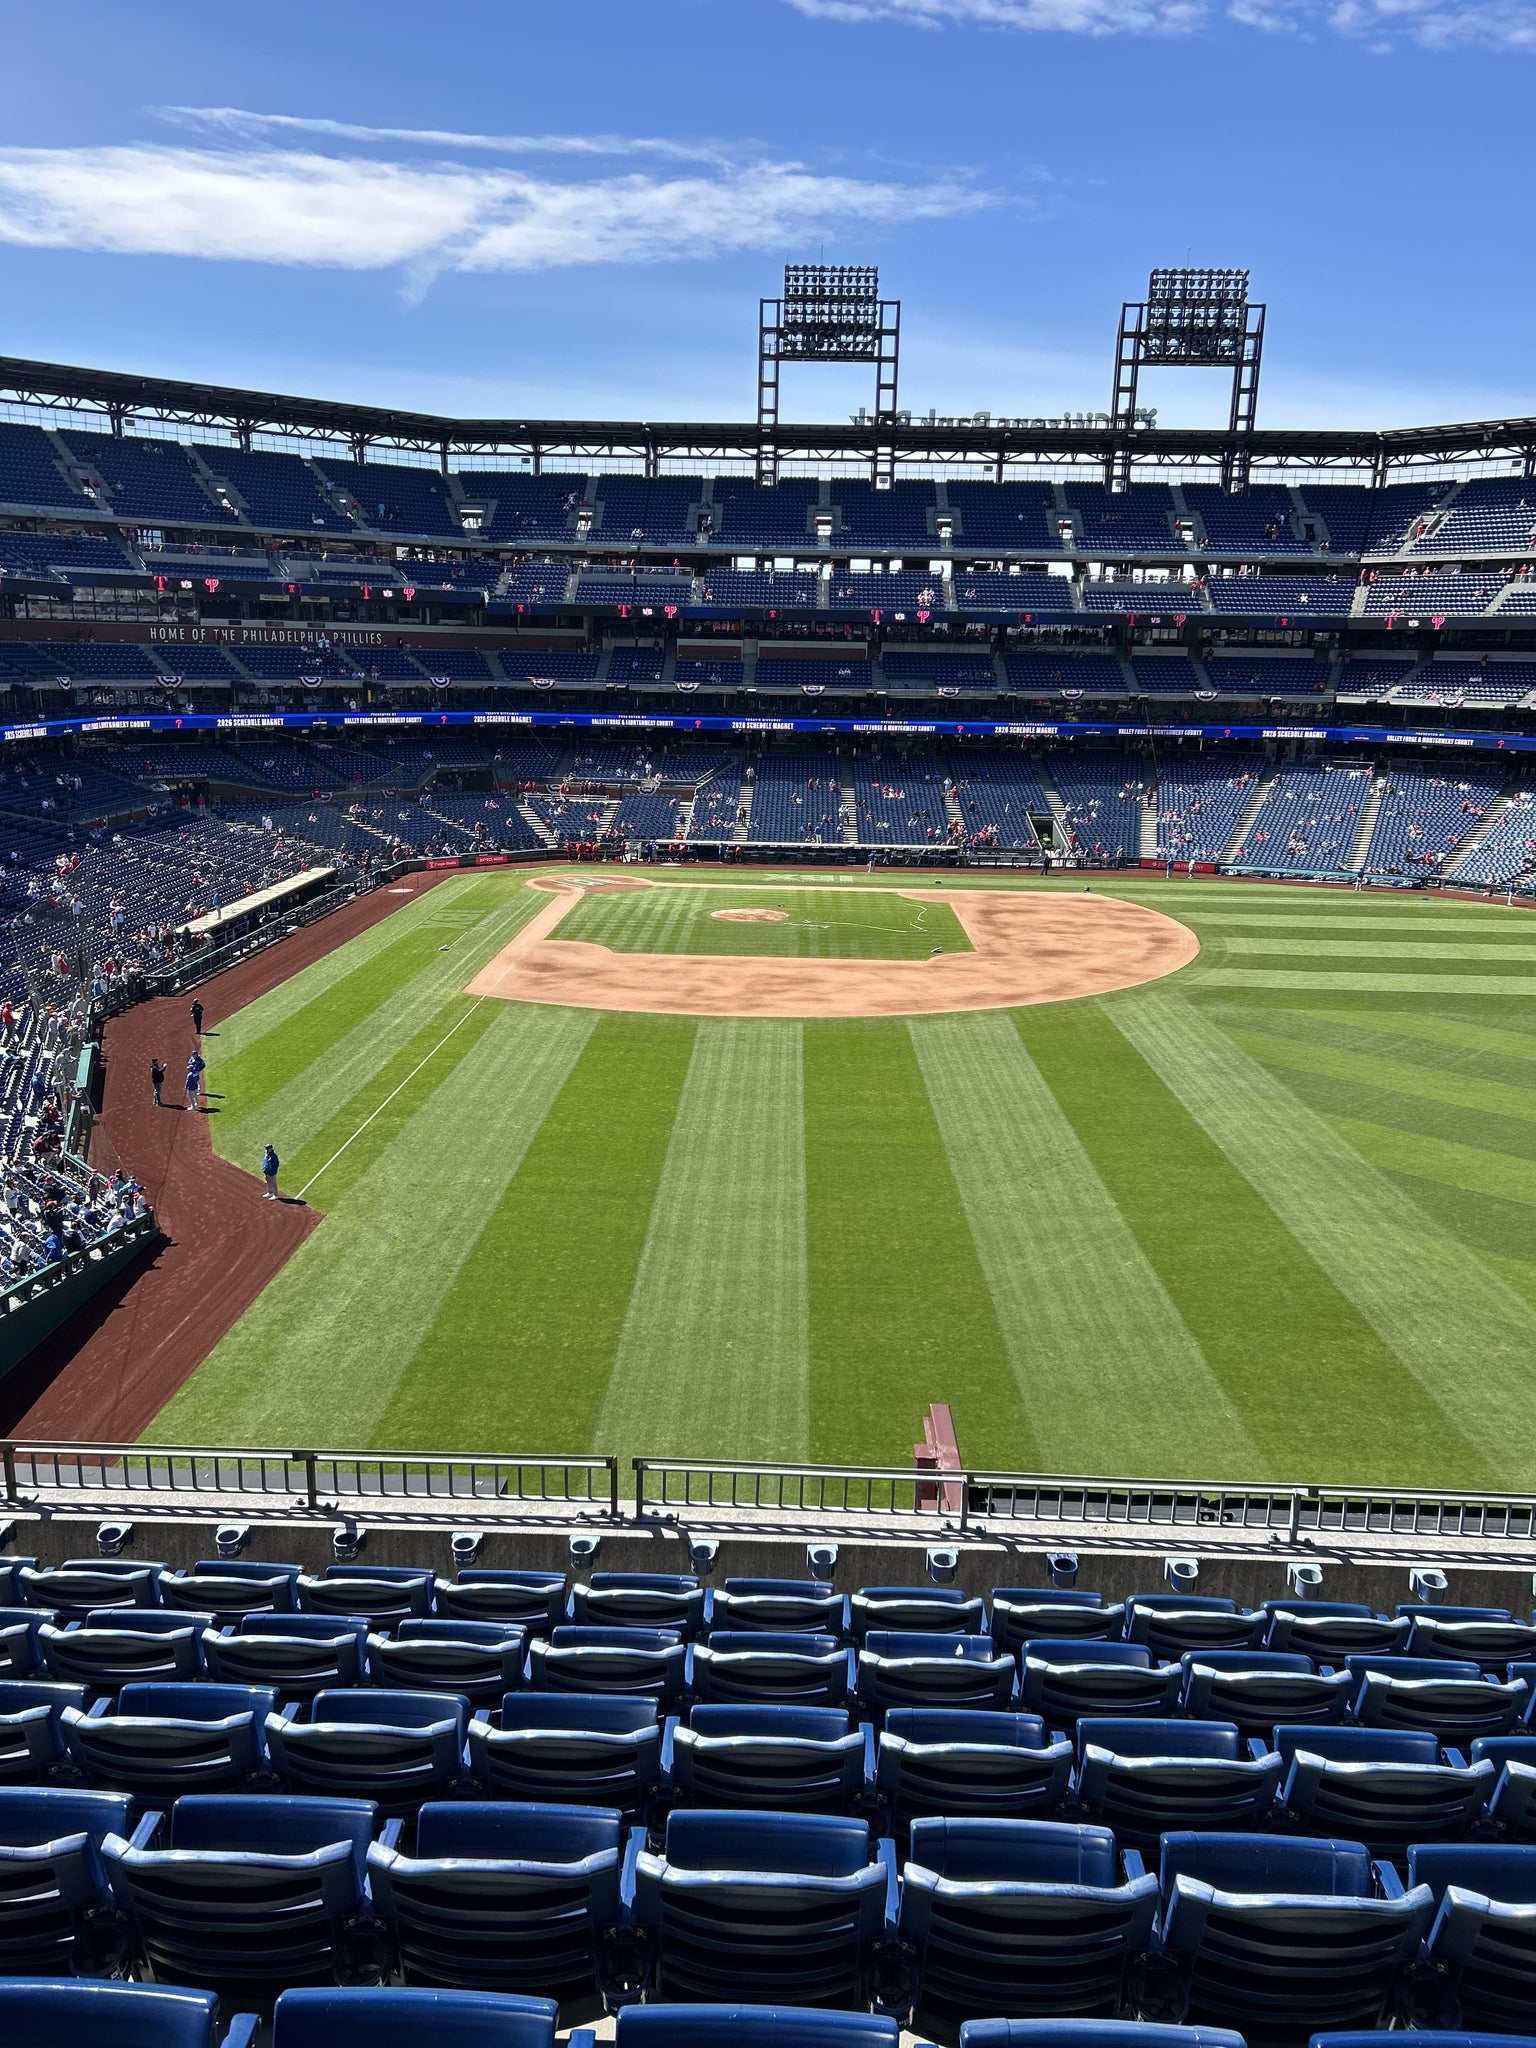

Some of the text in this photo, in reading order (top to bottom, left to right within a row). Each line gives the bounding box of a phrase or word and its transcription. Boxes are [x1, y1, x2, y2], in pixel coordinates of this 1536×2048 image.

[150, 627, 382, 644] HOME OF THE PHILADELPHIA PHILLIES
[261, 718, 284, 726] MAGNET
[1277, 730, 1304, 738] SCHEDULE
